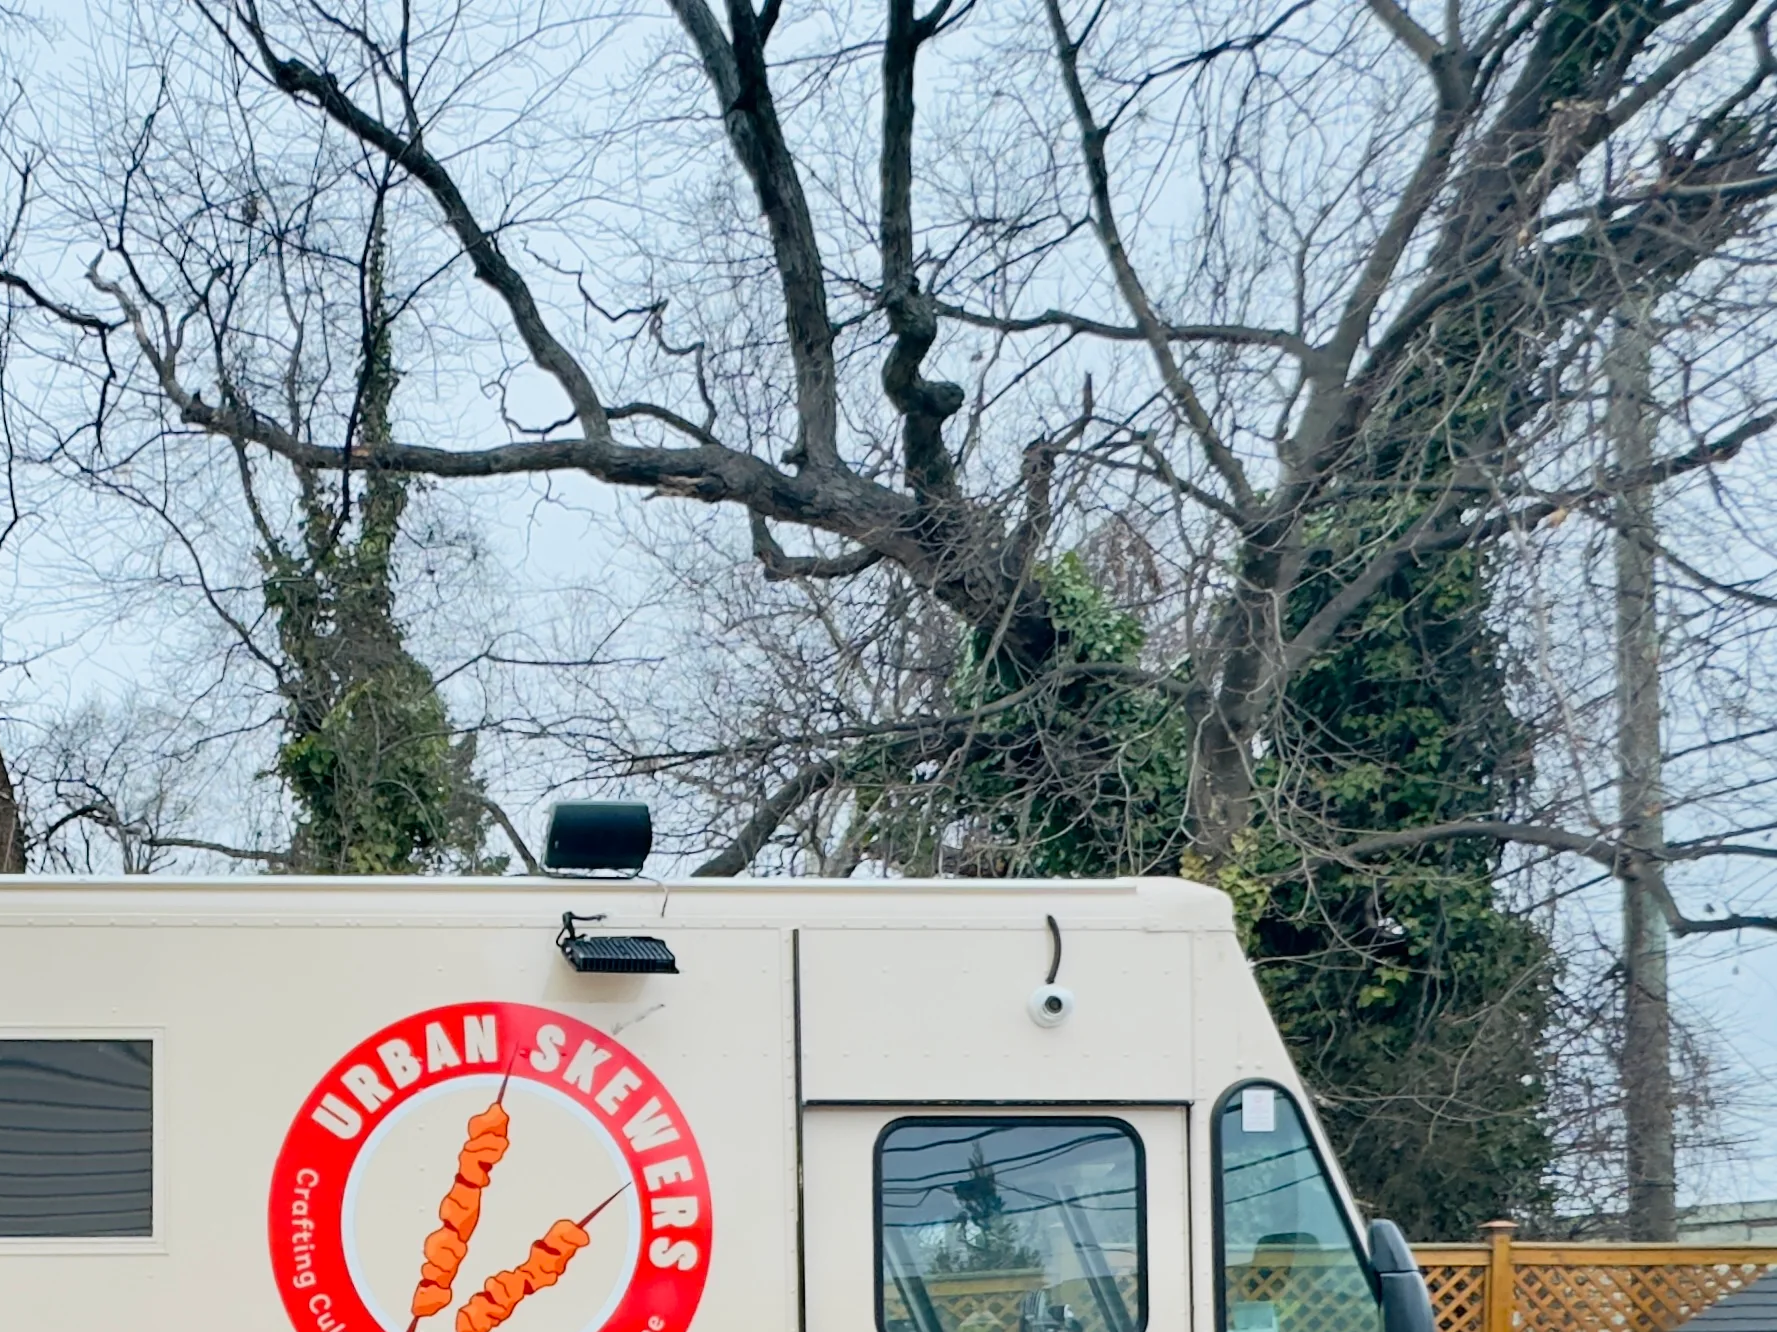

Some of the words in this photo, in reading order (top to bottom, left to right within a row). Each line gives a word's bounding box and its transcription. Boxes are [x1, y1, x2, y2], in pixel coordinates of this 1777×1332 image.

[291, 1167, 319, 1290] Crafting
[311, 1014, 498, 1141] URBAN
[528, 1024, 700, 1272] SKEWERS
